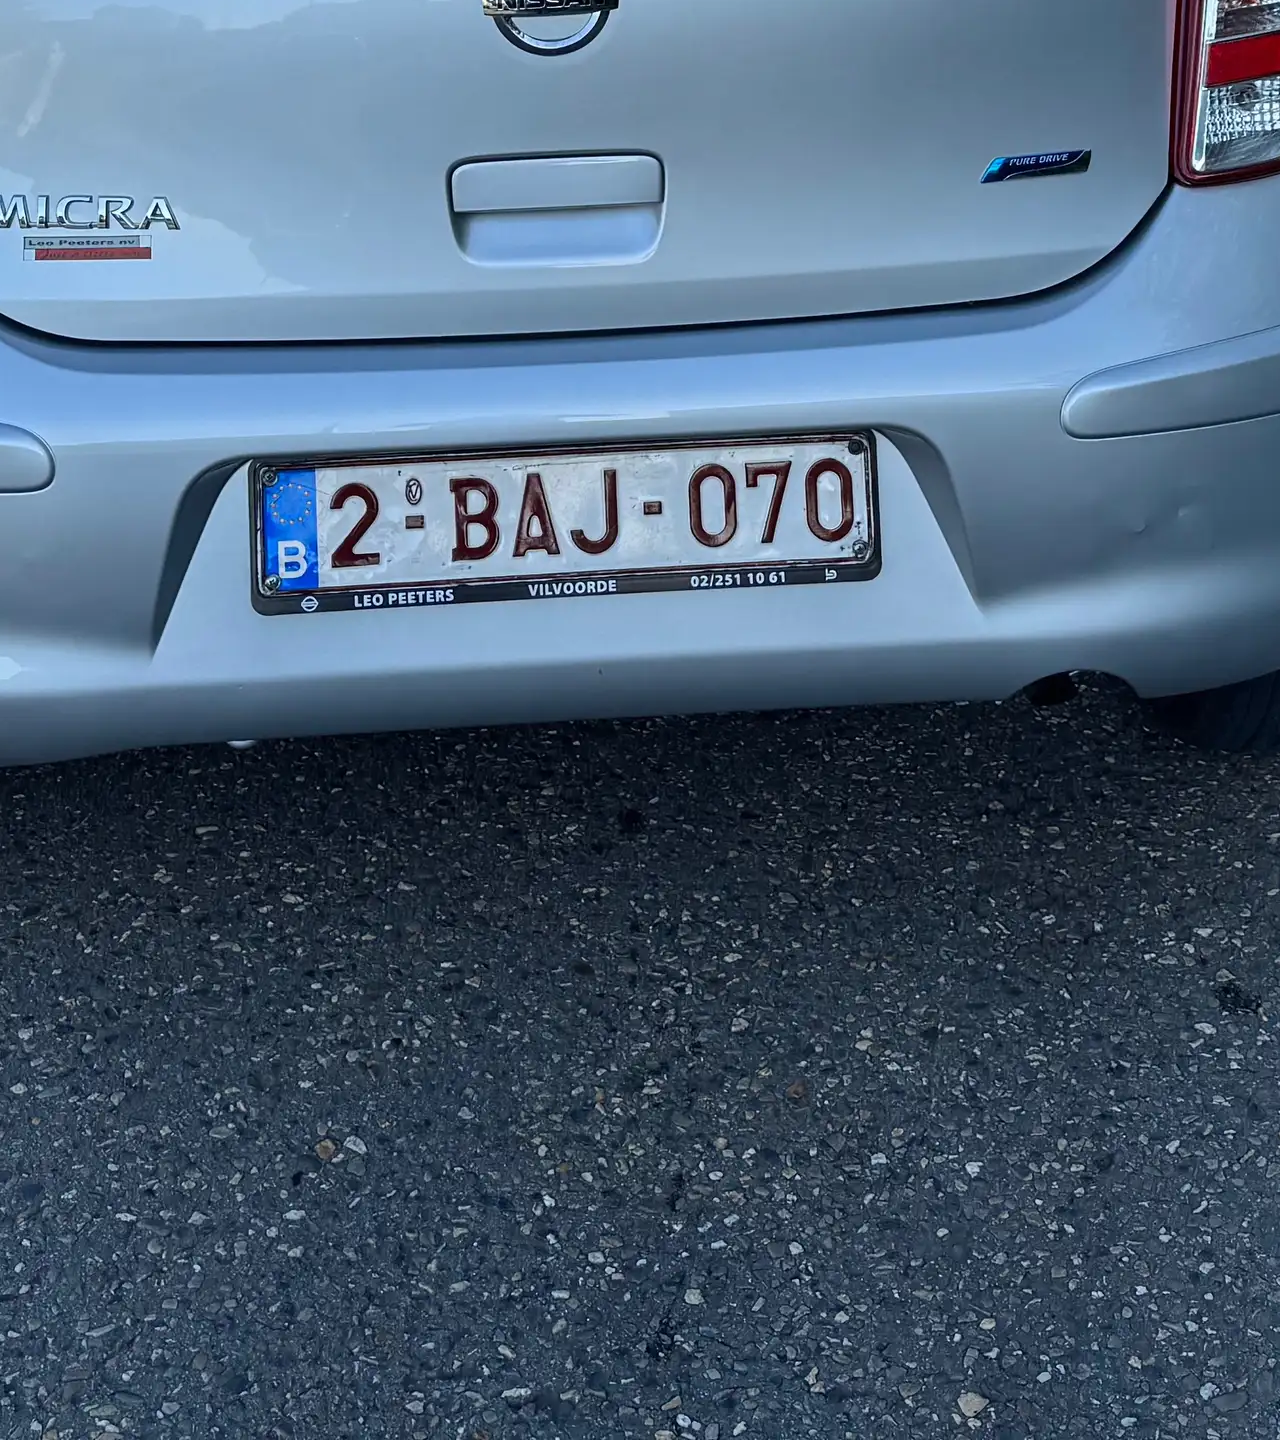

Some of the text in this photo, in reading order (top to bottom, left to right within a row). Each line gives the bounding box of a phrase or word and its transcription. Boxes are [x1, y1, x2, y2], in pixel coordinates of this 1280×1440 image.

[1009, 153, 1069, 166] PURE DRIVE
[28, 239, 54, 247] Leo
[329, 457, 855, 569] 2-BAJ-070
[277, 540, 307, 579] B
[528, 580, 617, 596] VILVOORDE
[690, 571, 786, 588] 02/251 10 61
[354, 589, 455, 608] LEO PEETERS
